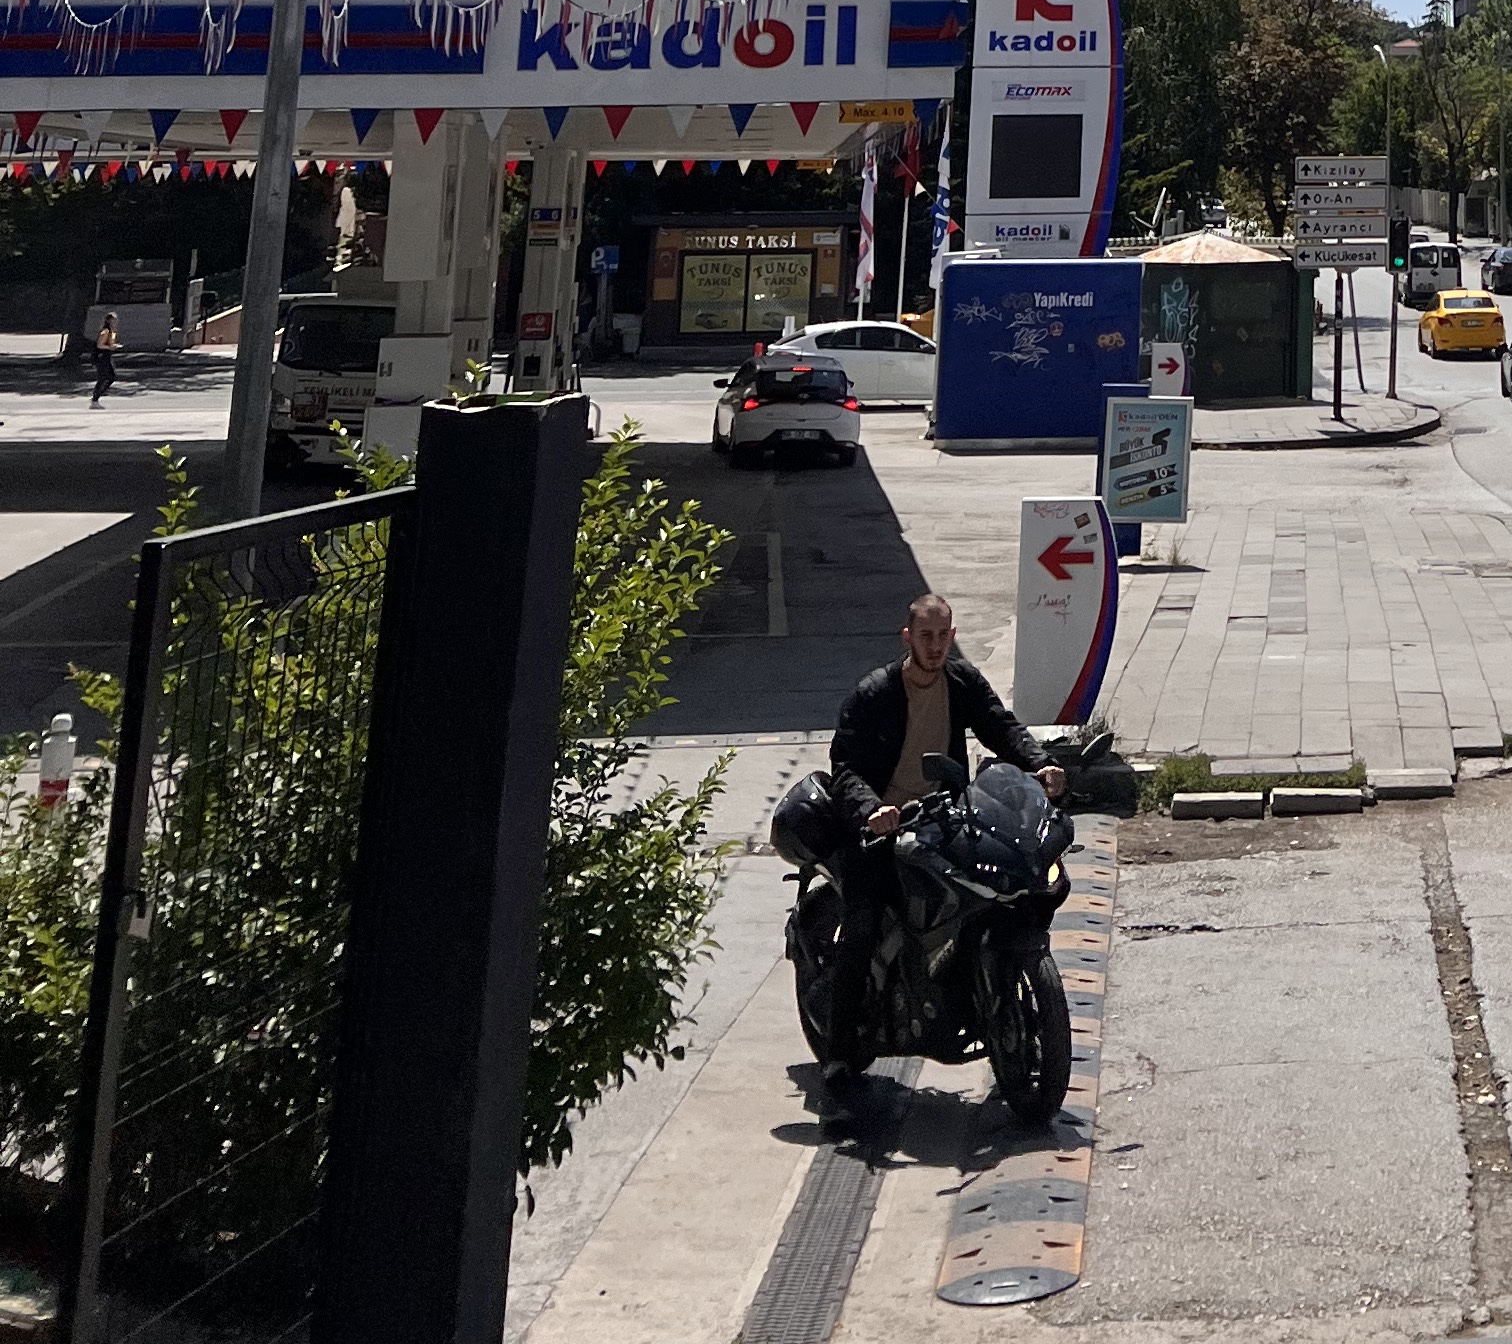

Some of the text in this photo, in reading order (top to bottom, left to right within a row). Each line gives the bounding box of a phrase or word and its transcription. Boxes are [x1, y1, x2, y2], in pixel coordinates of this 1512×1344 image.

[517, 5, 857, 71] kadoil
[989, 31, 1096, 51] kadoil
[1313, 165, 1366, 177] Kızılay
[995, 224, 1052, 236] kadoil
[1312, 223, 1372, 235] Ayrancı
[685, 232, 797, 249] TUNUS TAKSİ
[1314, 250, 1377, 263] Küçükesat
[687, 262, 743, 279] TUNUS
[753, 262, 808, 279] TUNUS
